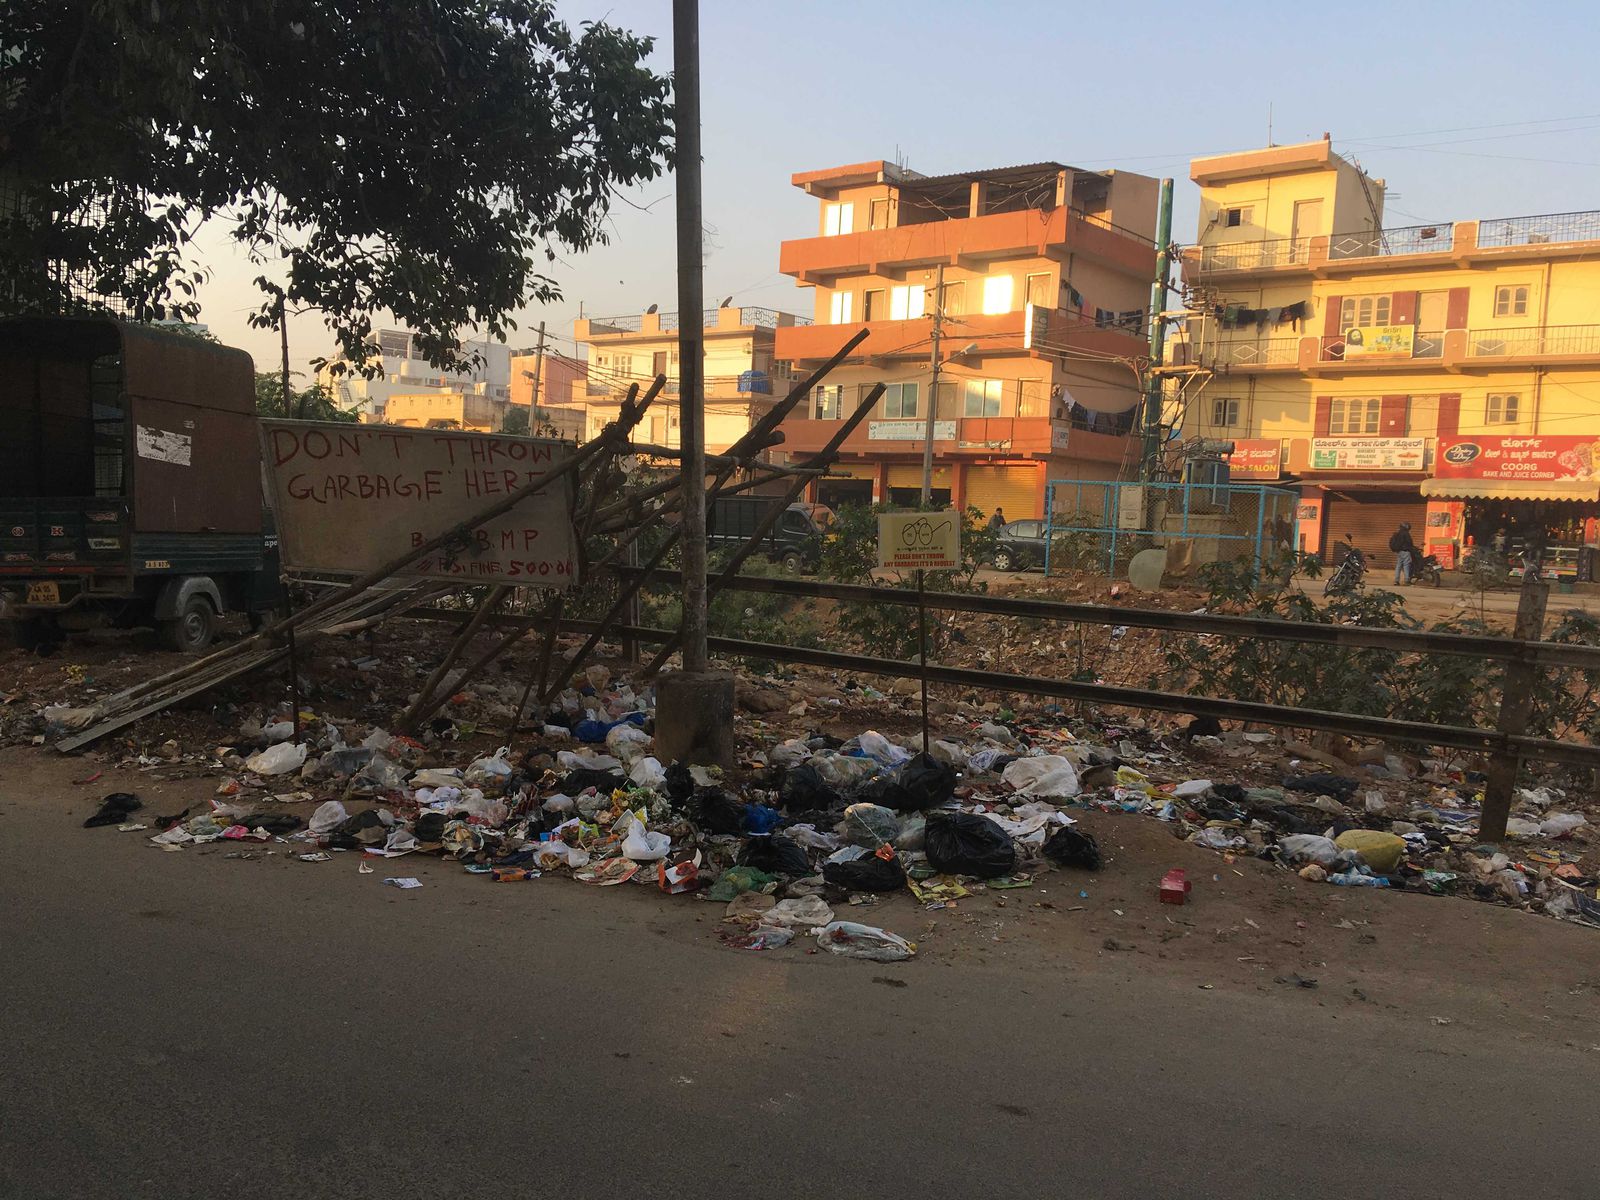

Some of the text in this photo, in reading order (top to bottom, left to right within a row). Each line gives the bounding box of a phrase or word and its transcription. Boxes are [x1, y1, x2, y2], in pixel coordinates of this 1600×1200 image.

[270, 428, 552, 467] DON'T THROW
[1453, 453, 1471, 462] Day
[1248, 464, 1277, 472] SALON
[1501, 462, 1538, 471] COORG
